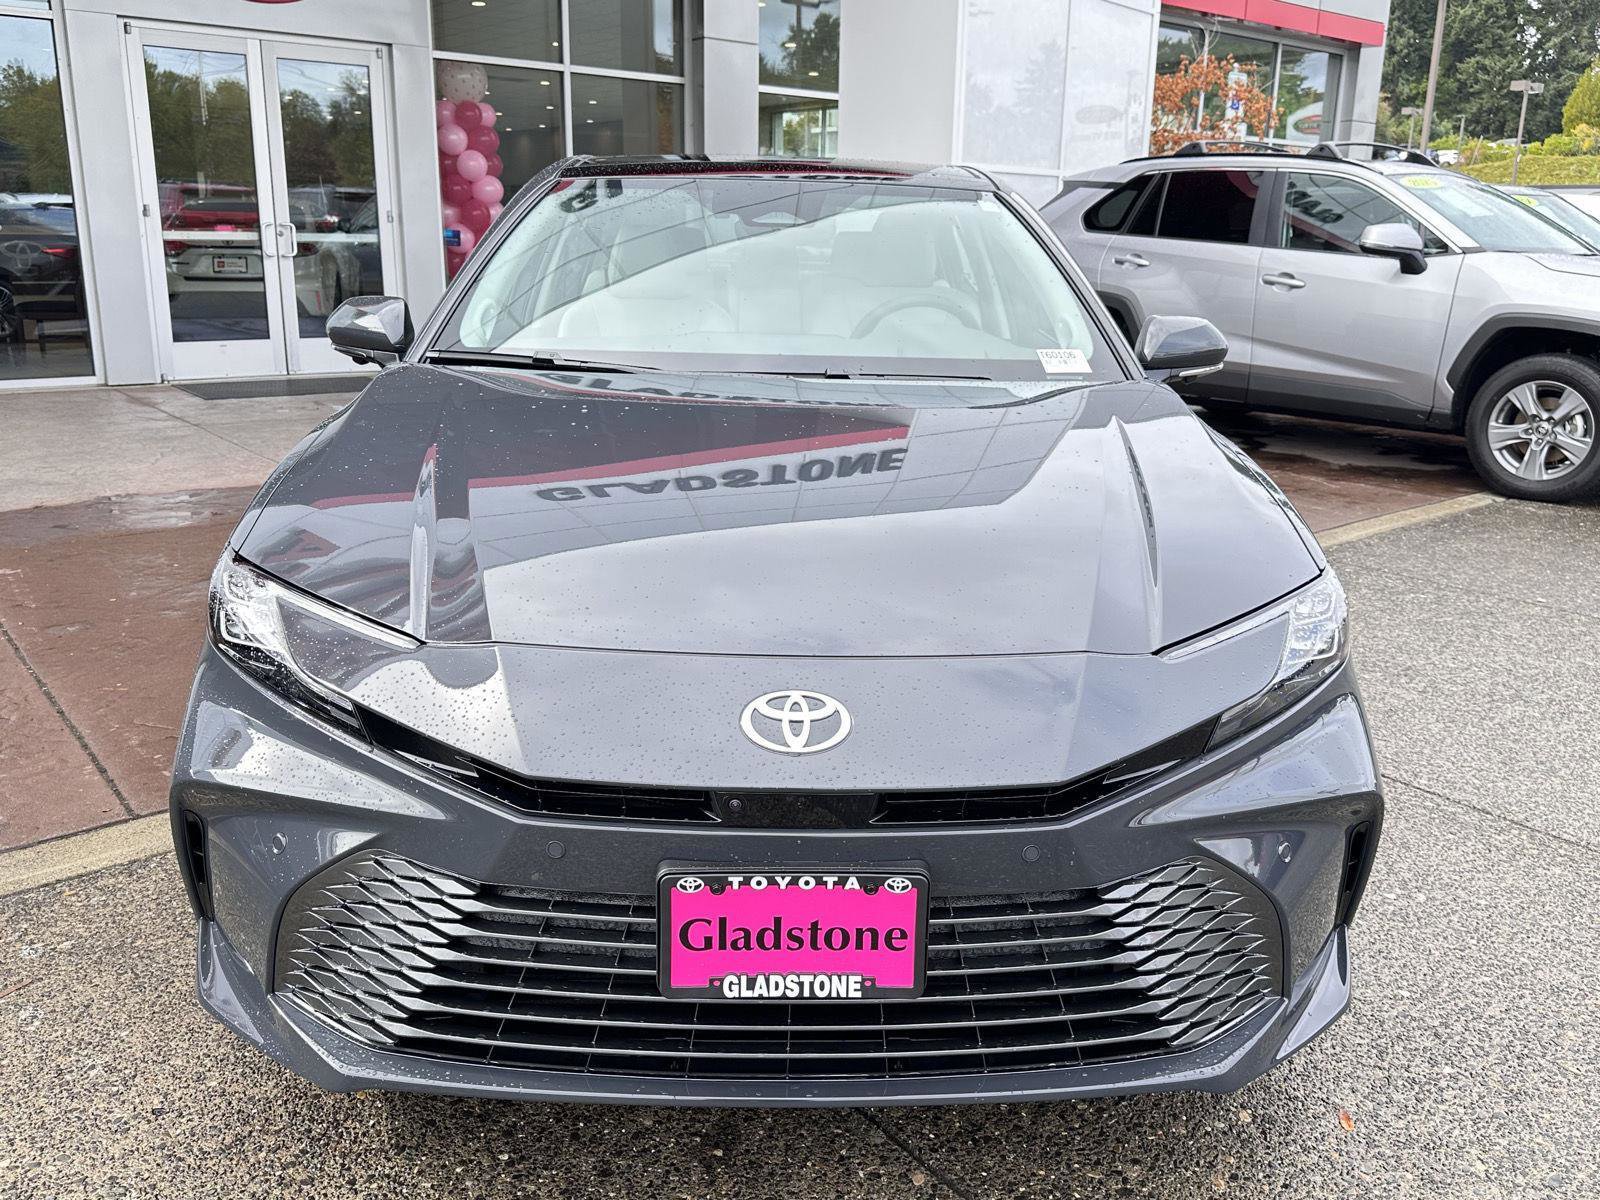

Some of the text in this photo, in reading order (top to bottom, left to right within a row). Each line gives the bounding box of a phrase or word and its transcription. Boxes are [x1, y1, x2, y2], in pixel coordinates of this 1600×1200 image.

[728, 876, 862, 890] TOYOTA
[678, 916, 909, 952] Gladstone
[722, 975, 863, 998] GLADSTONE
